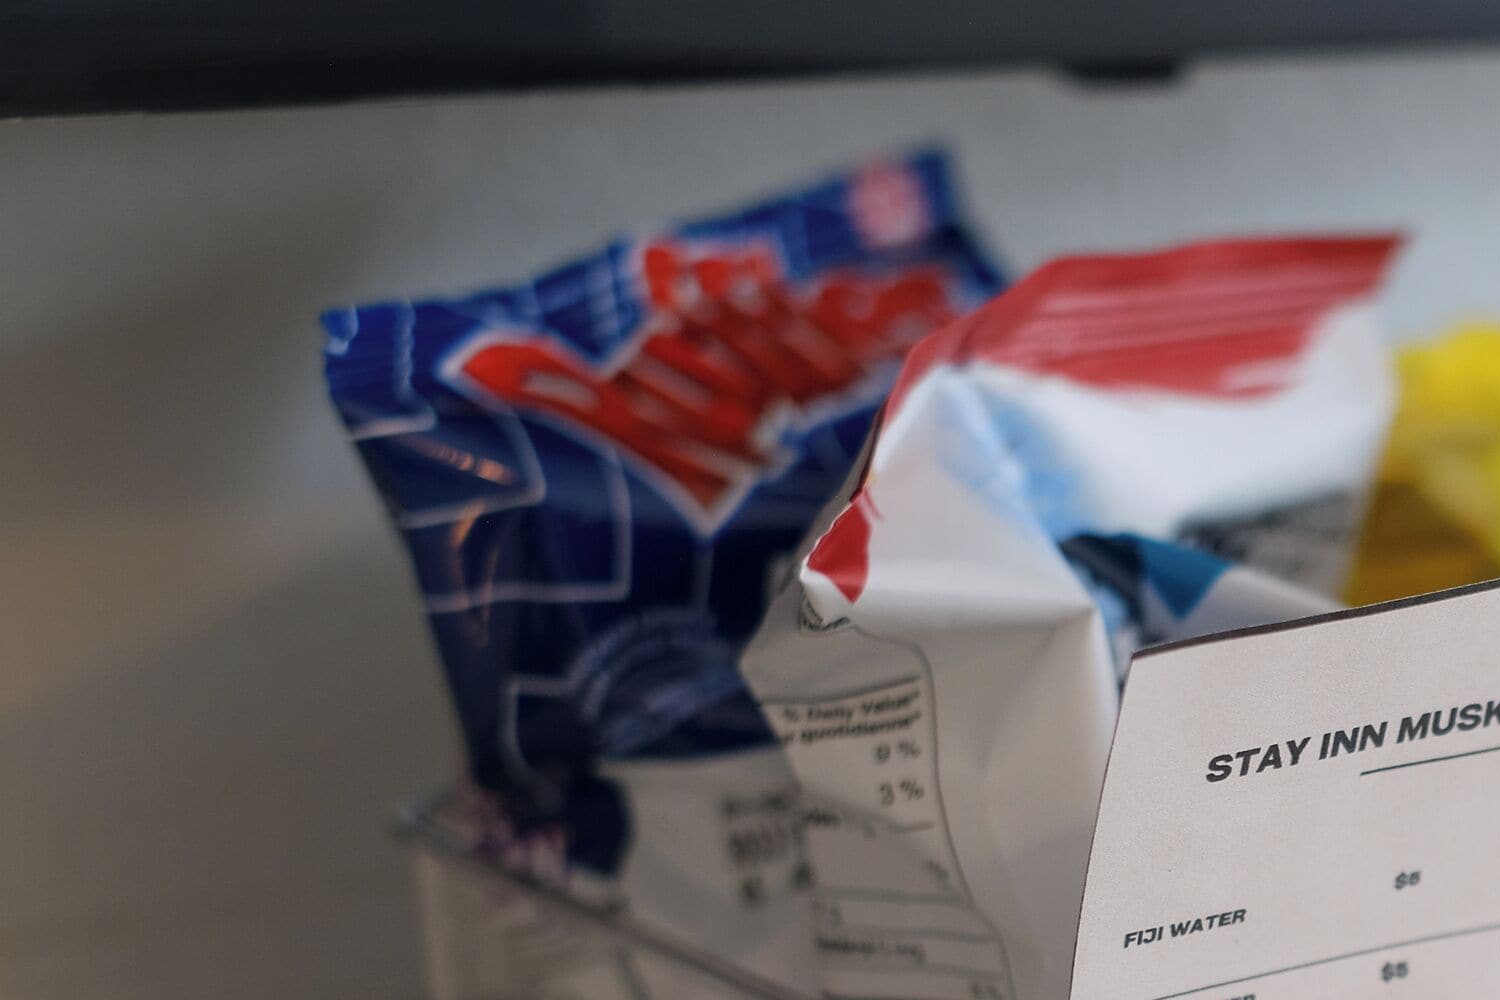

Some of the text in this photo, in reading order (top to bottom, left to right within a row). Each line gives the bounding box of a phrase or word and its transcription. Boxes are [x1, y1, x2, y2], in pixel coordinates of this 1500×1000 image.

[1205, 736, 1311, 783] STAY
[1318, 721, 1388, 760] INN
[1123, 908, 1247, 949] FIJI WATER
